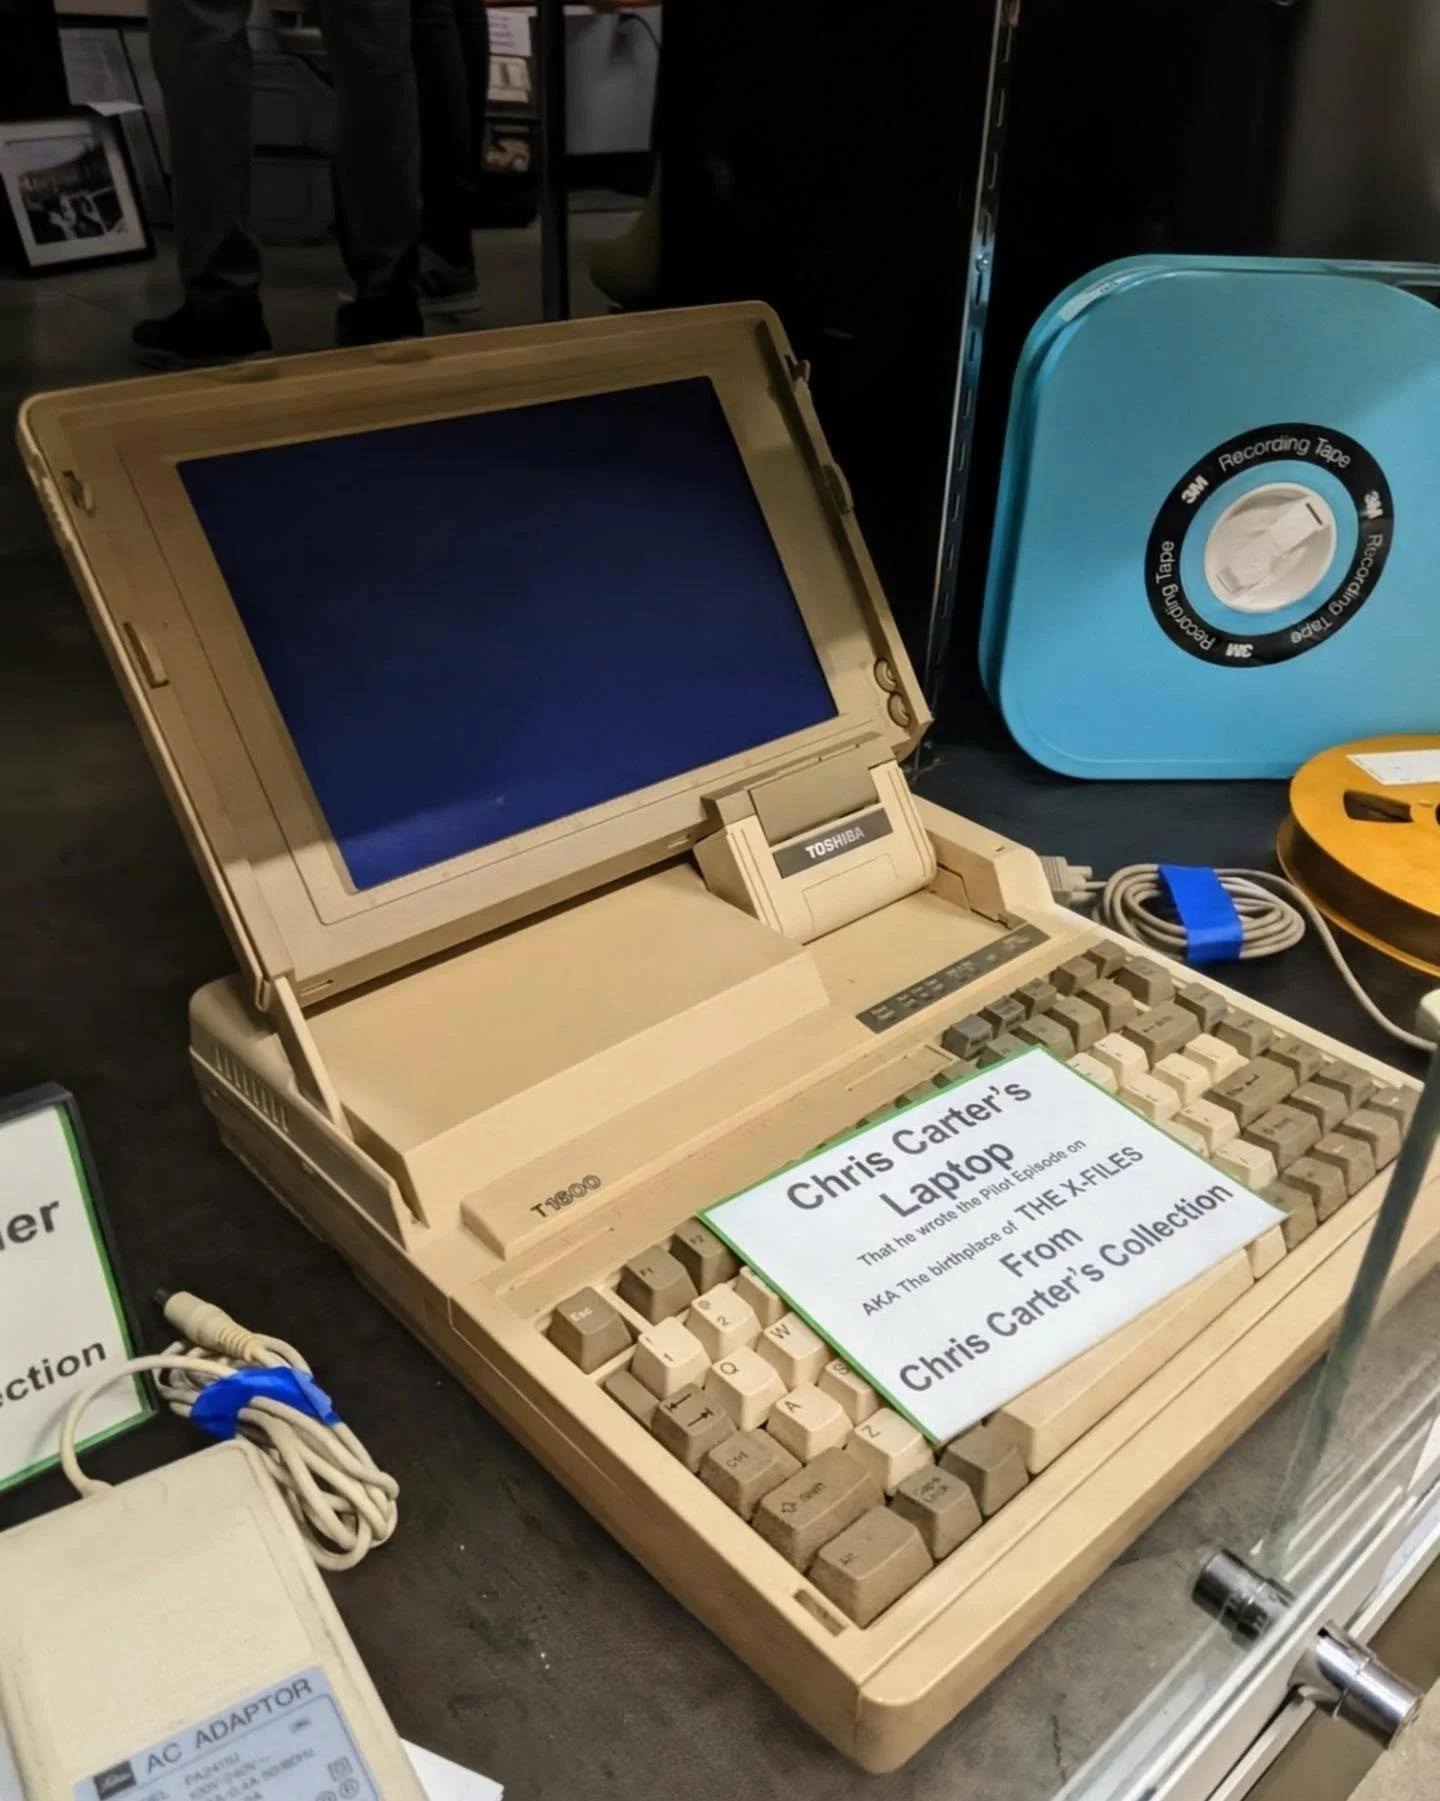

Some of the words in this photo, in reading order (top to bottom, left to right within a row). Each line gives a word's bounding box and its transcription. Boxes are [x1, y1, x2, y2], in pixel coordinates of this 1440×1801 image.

[1181, 475, 1209, 504] 3M
[1218, 435, 1311, 472] Recording
[1315, 437, 1351, 469] Tape
[1364, 490, 1384, 519] 3M
[1155, 540, 1176, 585] Tape
[1328, 533, 1383, 617] Recording
[1160, 582, 1216, 651] Recording
[1290, 615, 1334, 645] Tape
[1225, 642, 1254, 659] 3M
[805, 826, 865, 859] TOSHIBA
[787, 1152, 894, 1211] Chris
[892, 1082, 1032, 1155] Carter's
[879, 1143, 1015, 1218] Laptop
[856, 1243, 897, 1267] That
[896, 1232, 917, 1249] he
[918, 1210, 958, 1236] wrote
[956, 1197, 982, 1215] the
[979, 1177, 1016, 1201] Pilot
[1011, 1152, 1067, 1184] Episode
[1066, 1139, 1088, 1154] on
[0, 1201, 60, 1250] er
[861, 1290, 901, 1316] AKA
[896, 1272, 930, 1294] The
[928, 1230, 1003, 1276] birthplace
[1001, 1219, 1019, 1236] of
[1014, 1189, 1068, 1223] THE
[1060, 1146, 1144, 1198] X-FILES
[998, 1227, 1084, 1278] From
[899, 1333, 991, 1392] Chris
[986, 1264, 1105, 1337] Carter's
[1098, 1184, 1234, 1268] Collection
[569, 1306, 593, 1322] Esc
[716, 1315, 730, 1327] 2
[770, 1323, 791, 1340] W
[719, 1361, 740, 1376] Q
[832, 1361, 849, 1376] S
[784, 1399, 802, 1414] A
[861, 1425, 881, 1440] Z
[725, 1450, 749, 1469] Ctrl
[148, 1742, 182, 1775] AC
[195, 1678, 312, 1749] ADAPTOR
